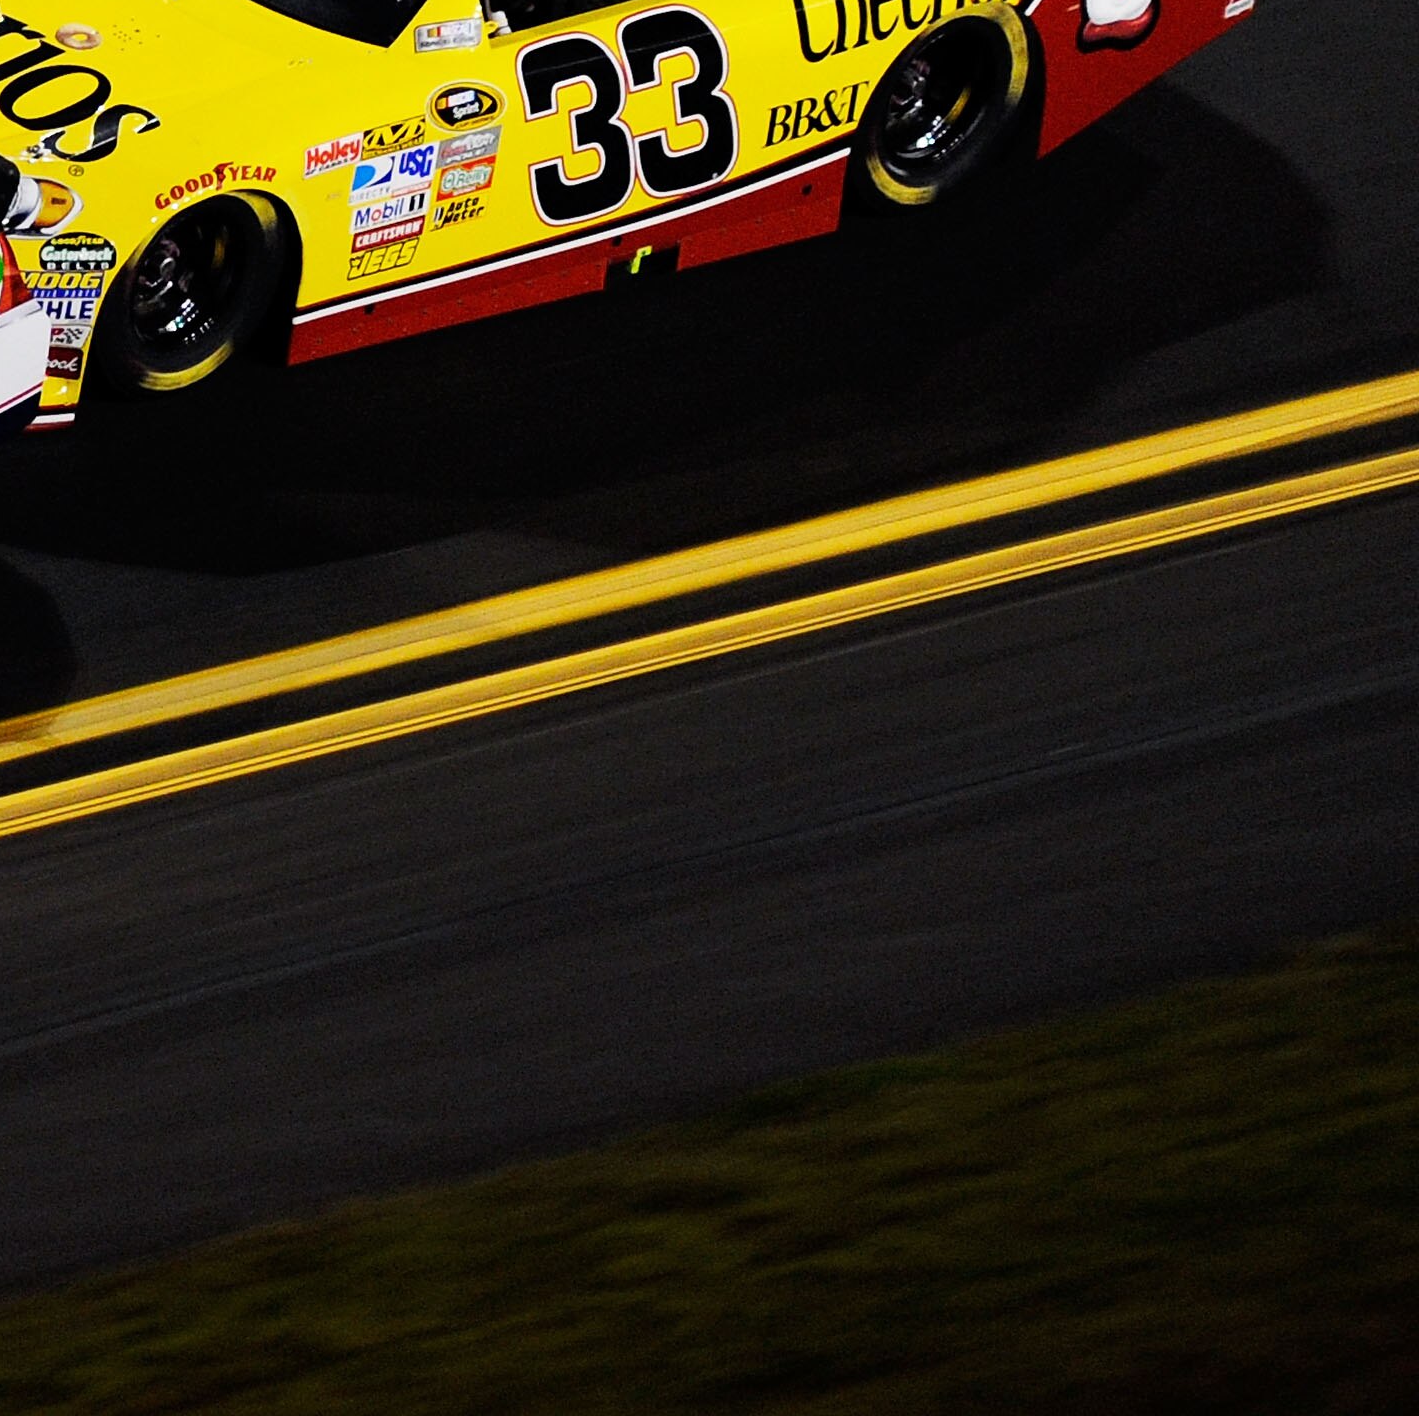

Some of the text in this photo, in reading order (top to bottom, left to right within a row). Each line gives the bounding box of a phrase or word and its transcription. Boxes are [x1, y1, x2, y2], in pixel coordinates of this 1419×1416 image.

[452, 100, 480, 120] Sprint
[516, 4, 738, 227] 33
[763, 80, 869, 148] BB&T
[306, 138, 361, 169] Holley
[399, 145, 434, 178] USG
[155, 162, 277, 210] GOODYEAR
[355, 199, 403, 227] Mobil
[443, 205, 484, 226] Meter
[447, 195, 480, 213] Auto
[355, 221, 423, 247] CRAFTSMAN
[347, 237, 420, 281] JEGS
